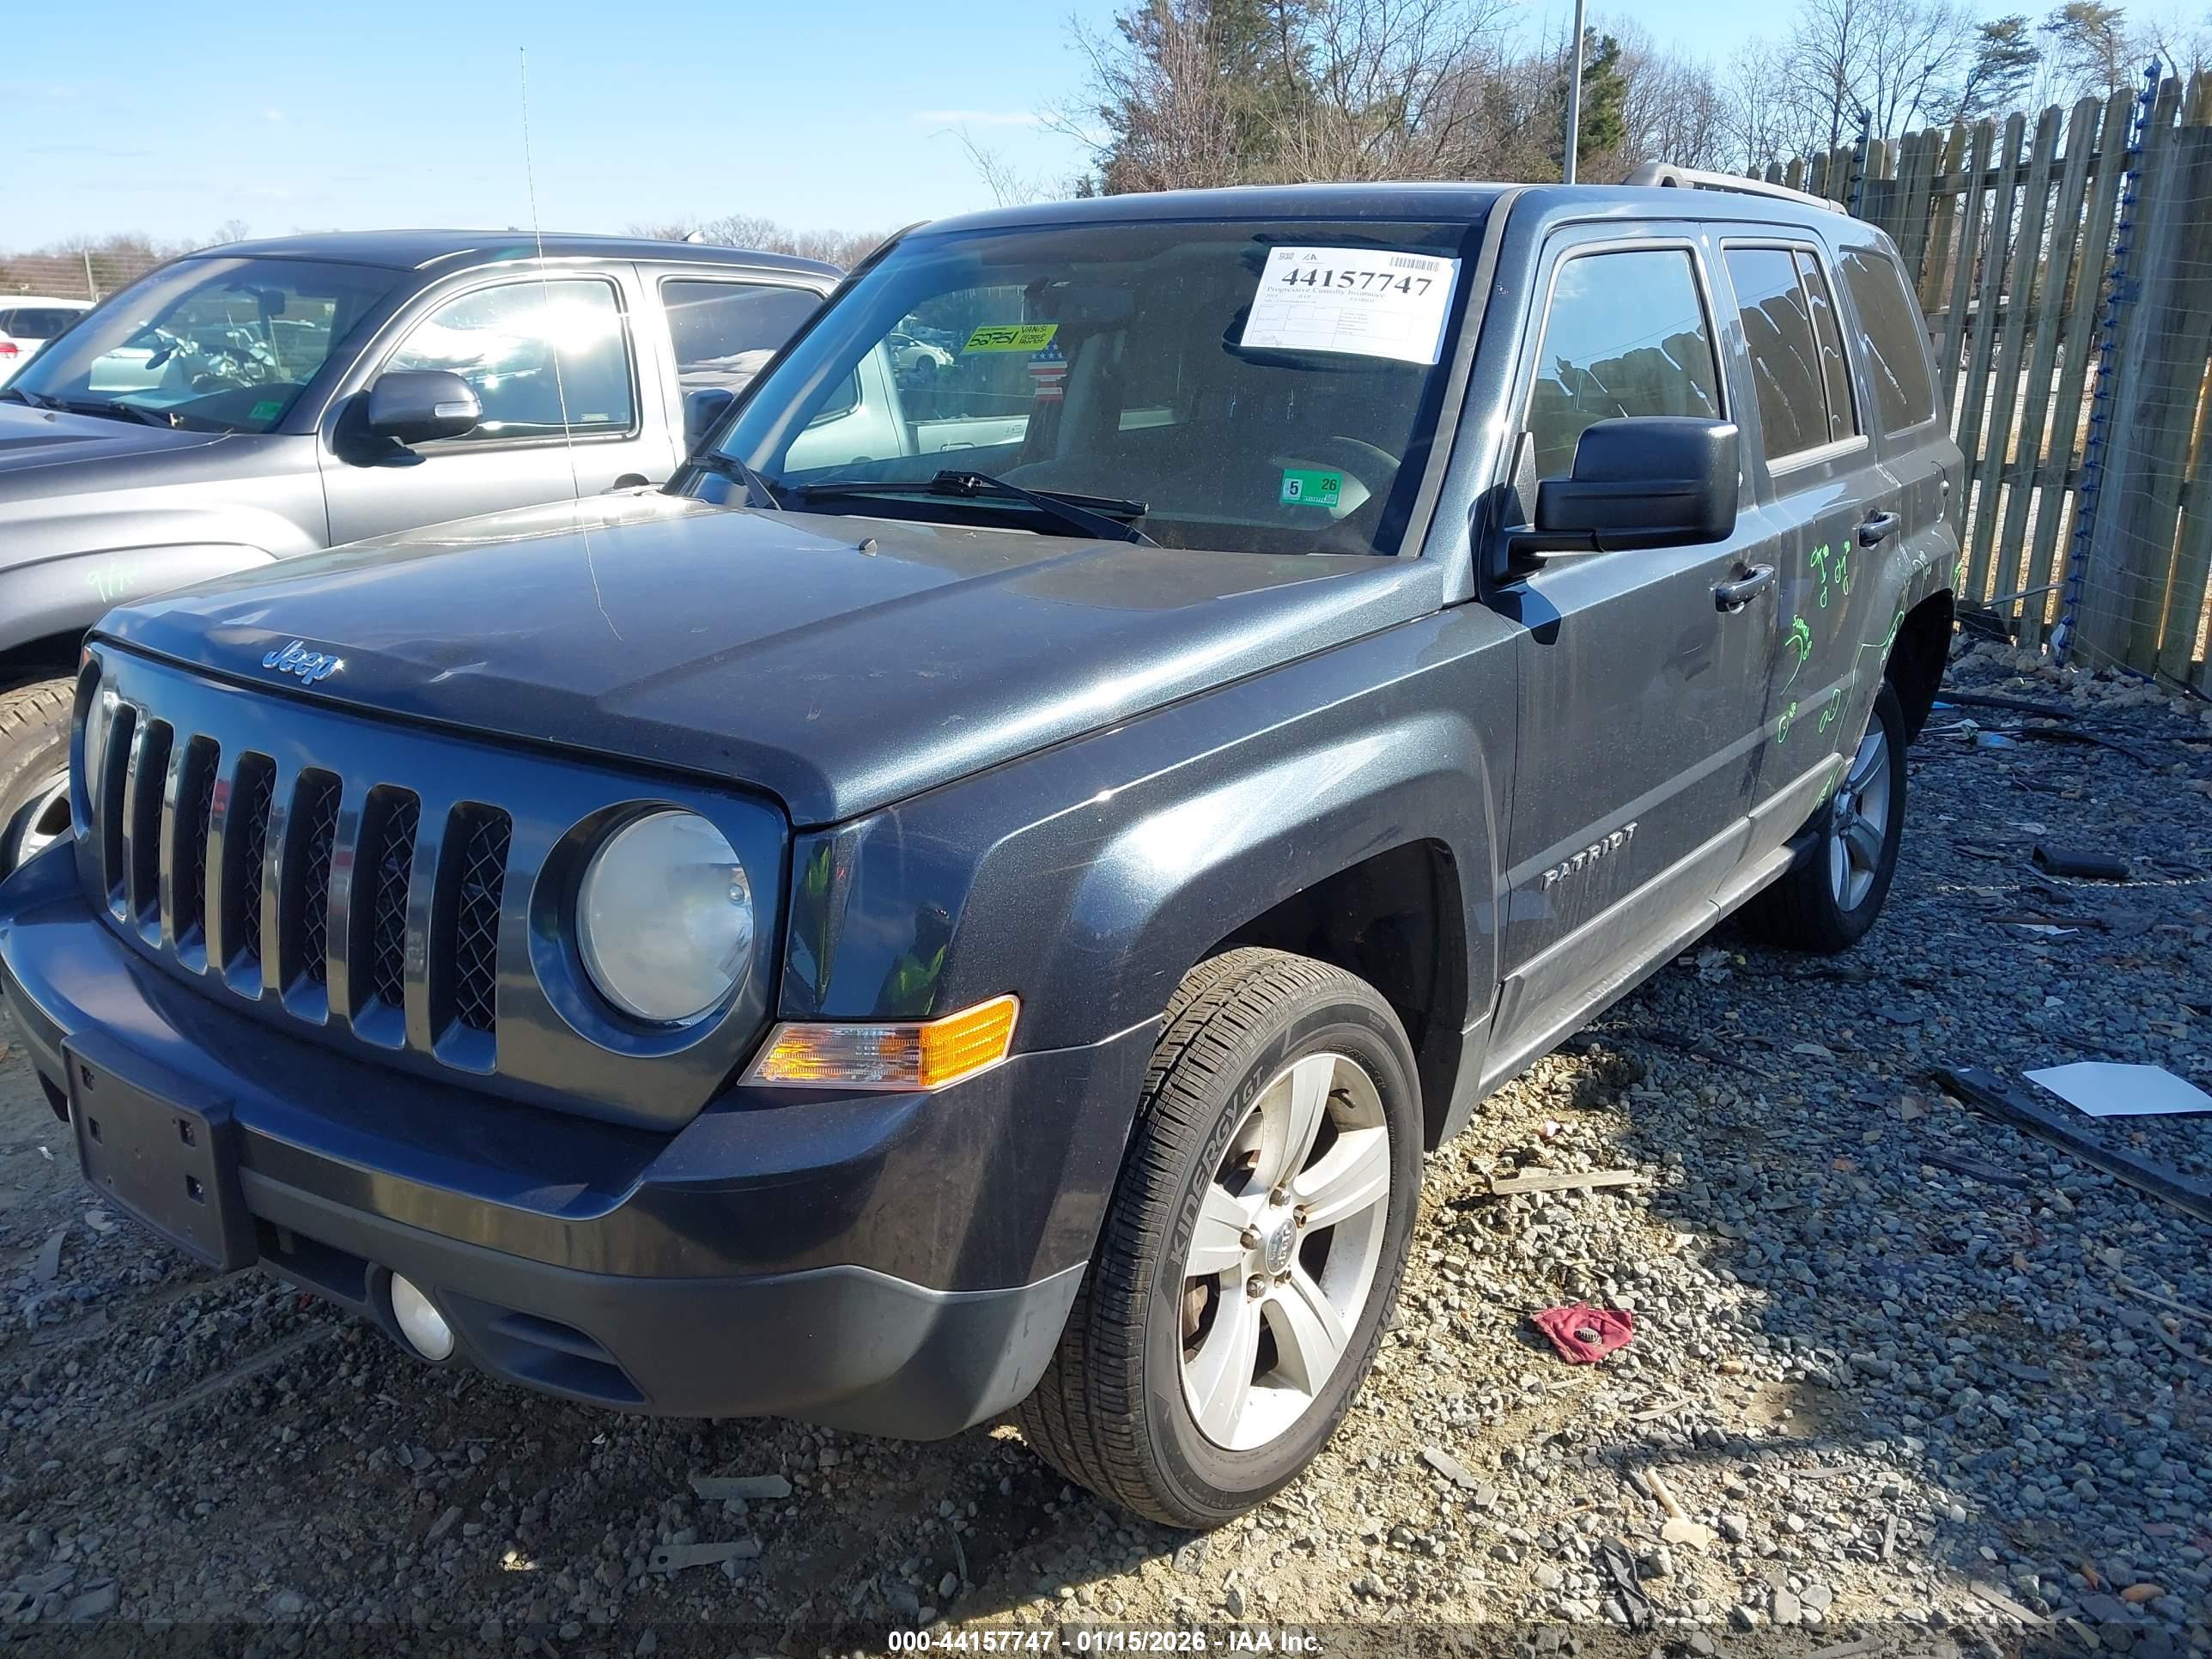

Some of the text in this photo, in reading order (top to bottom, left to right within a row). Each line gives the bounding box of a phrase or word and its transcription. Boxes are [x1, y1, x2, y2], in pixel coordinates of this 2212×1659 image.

[1281, 267, 1432, 296] 44157747
[1312, 287, 1346, 295] Casualty
[1347, 289, 1386, 298] Insurance
[1289, 477, 1338, 495] 5 26
[262, 640, 343, 685] Jeep
[1540, 821, 1638, 891] PATRIOT
[1170, 1066, 1265, 1266] KINERGY GT
